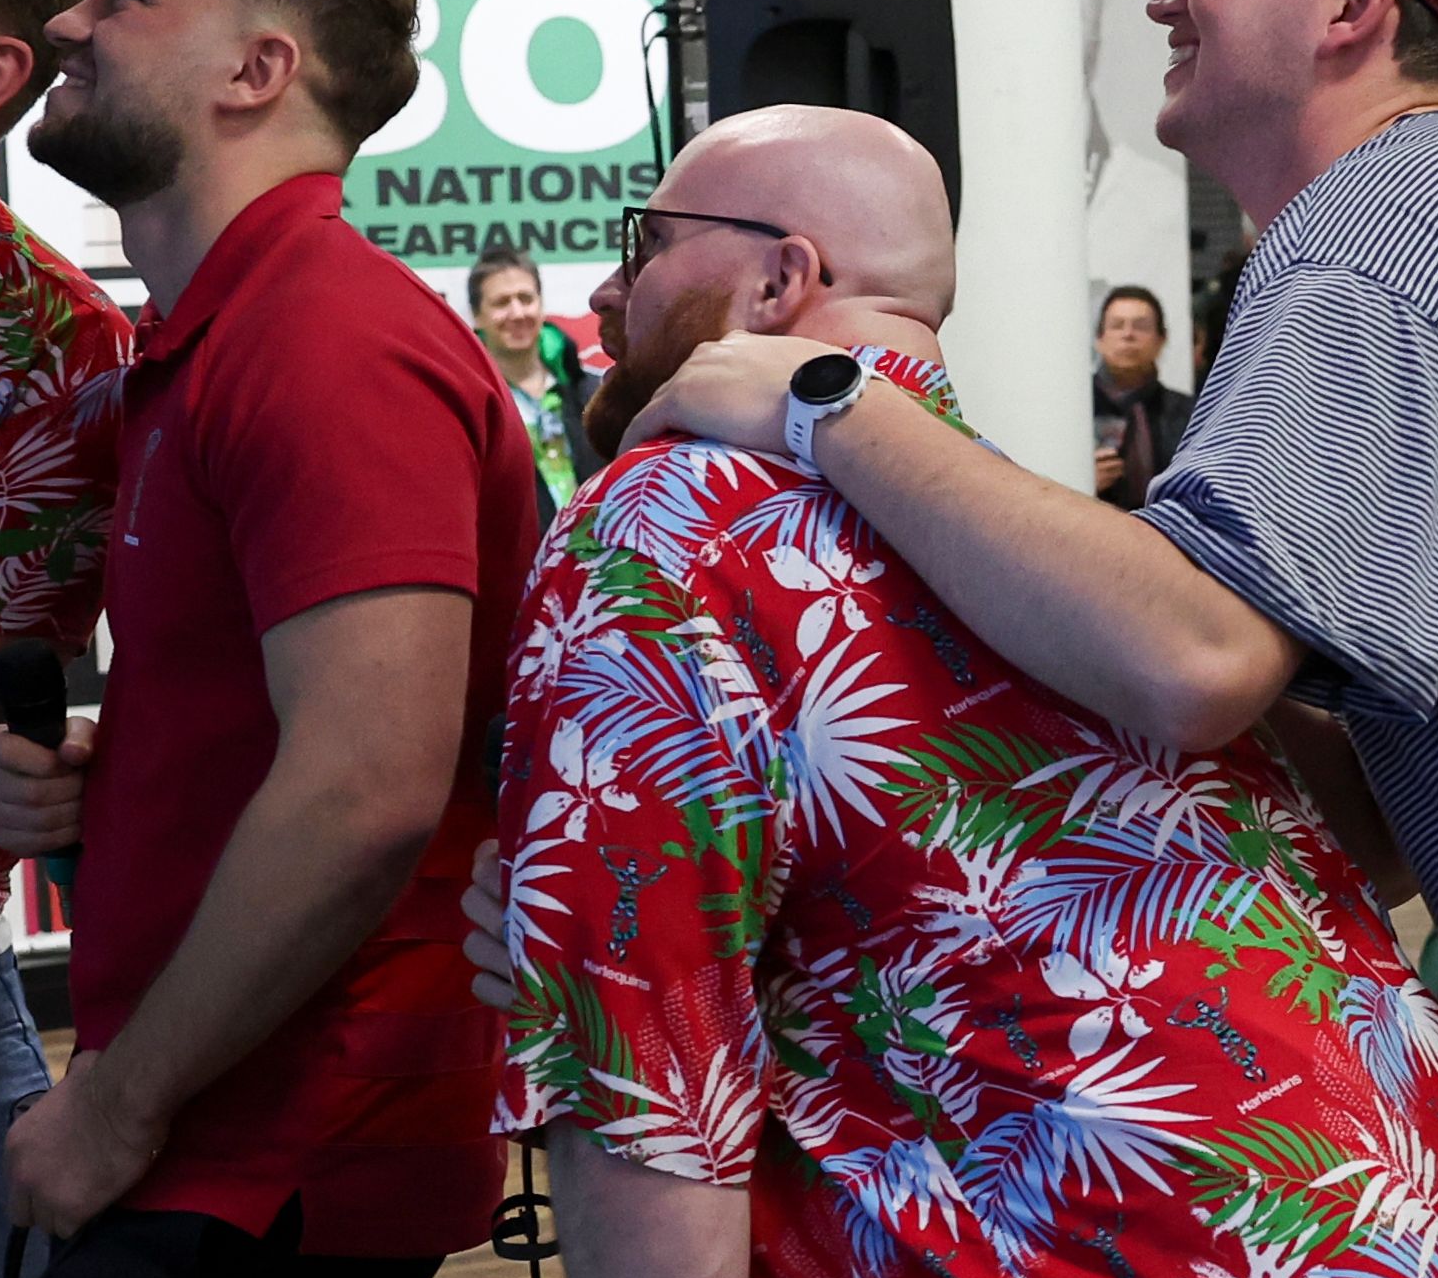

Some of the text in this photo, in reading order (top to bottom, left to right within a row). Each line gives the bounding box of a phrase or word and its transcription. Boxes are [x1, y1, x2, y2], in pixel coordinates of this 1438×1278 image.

[376, 163, 660, 208] NATIONS
[942, 679, 1012, 719] Harlequins
[582, 958, 651, 992] Harlequins
[1236, 1073, 1303, 1116] Harlequins
